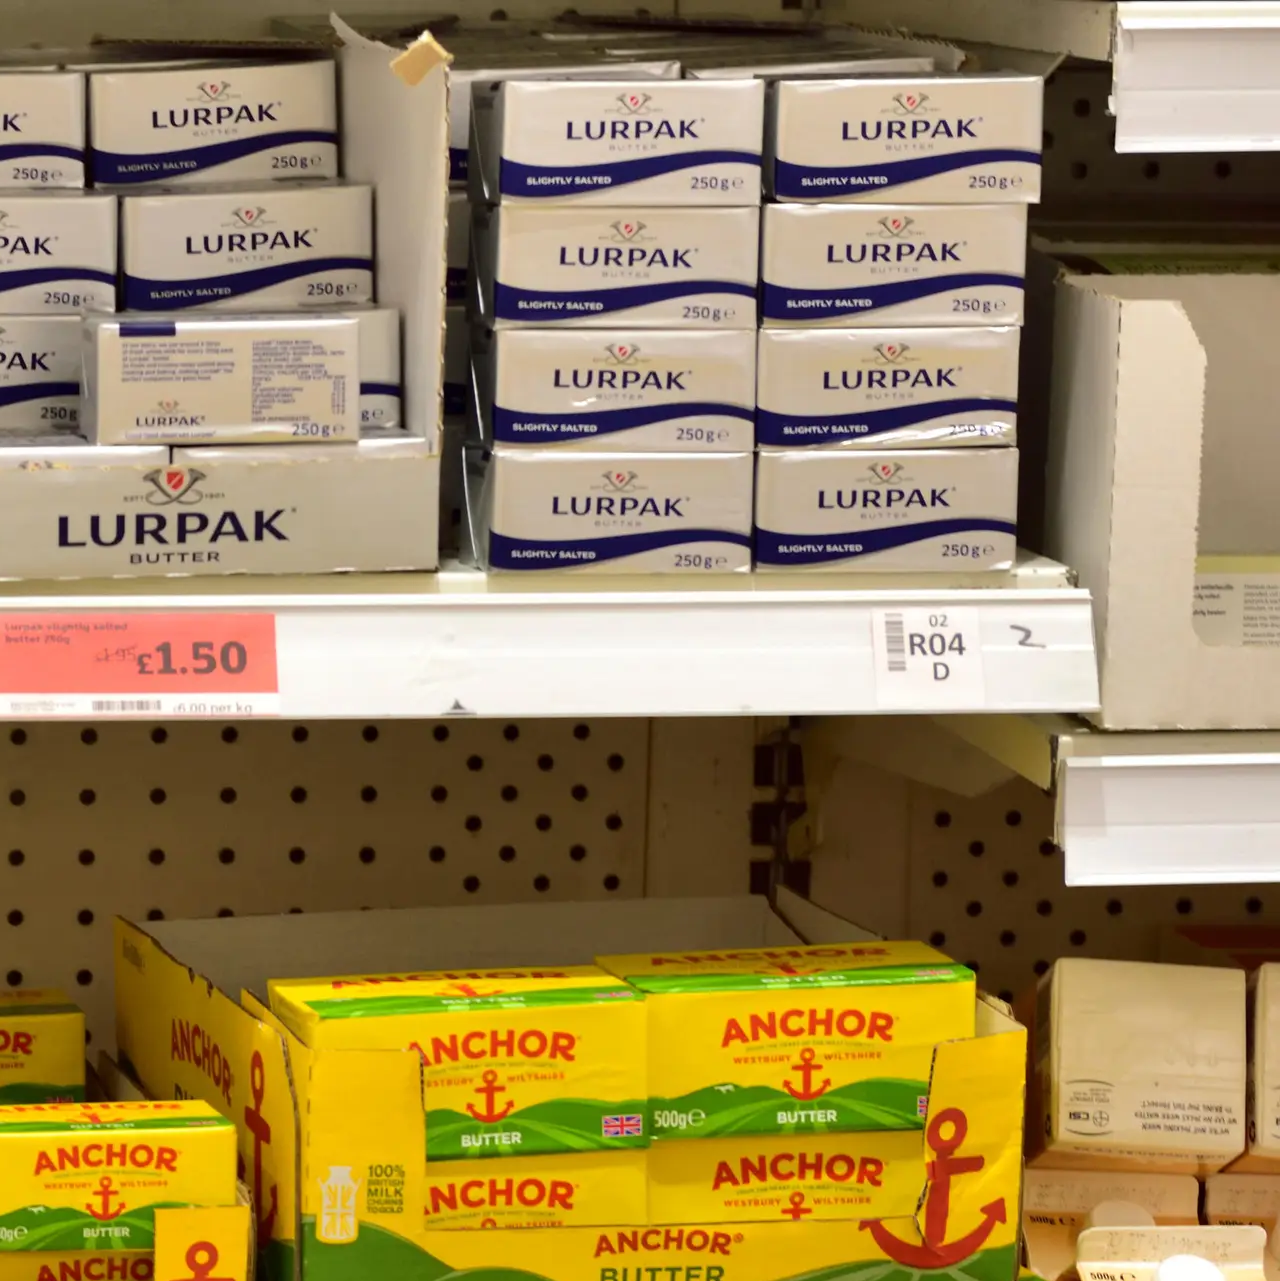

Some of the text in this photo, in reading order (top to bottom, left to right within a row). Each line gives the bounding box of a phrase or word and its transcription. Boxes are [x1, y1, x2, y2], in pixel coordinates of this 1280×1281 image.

[152, 103, 276, 129] LURPAK
[566, 119, 699, 141] LURPAK
[842, 118, 977, 142] LURPAK
[526, 176, 611, 186] SLIGHTLY SALTED
[185, 229, 312, 255] LURPAK
[559, 246, 692, 268] LURPAK
[58, 509, 290, 548] LURPAK
[130, 551, 220, 564] BUTTER
[929, 614, 948, 627] 02
[909, 633, 965, 656] R04
[138, 641, 247, 674] £1.50
[933, 663, 950, 680] D
[721, 1009, 894, 1047] ANCHOR
[777, 1109, 838, 1125] BUTTER
[34, 1143, 178, 1176] ANCHOR
[82, 1226, 130, 1238] BUTTER
